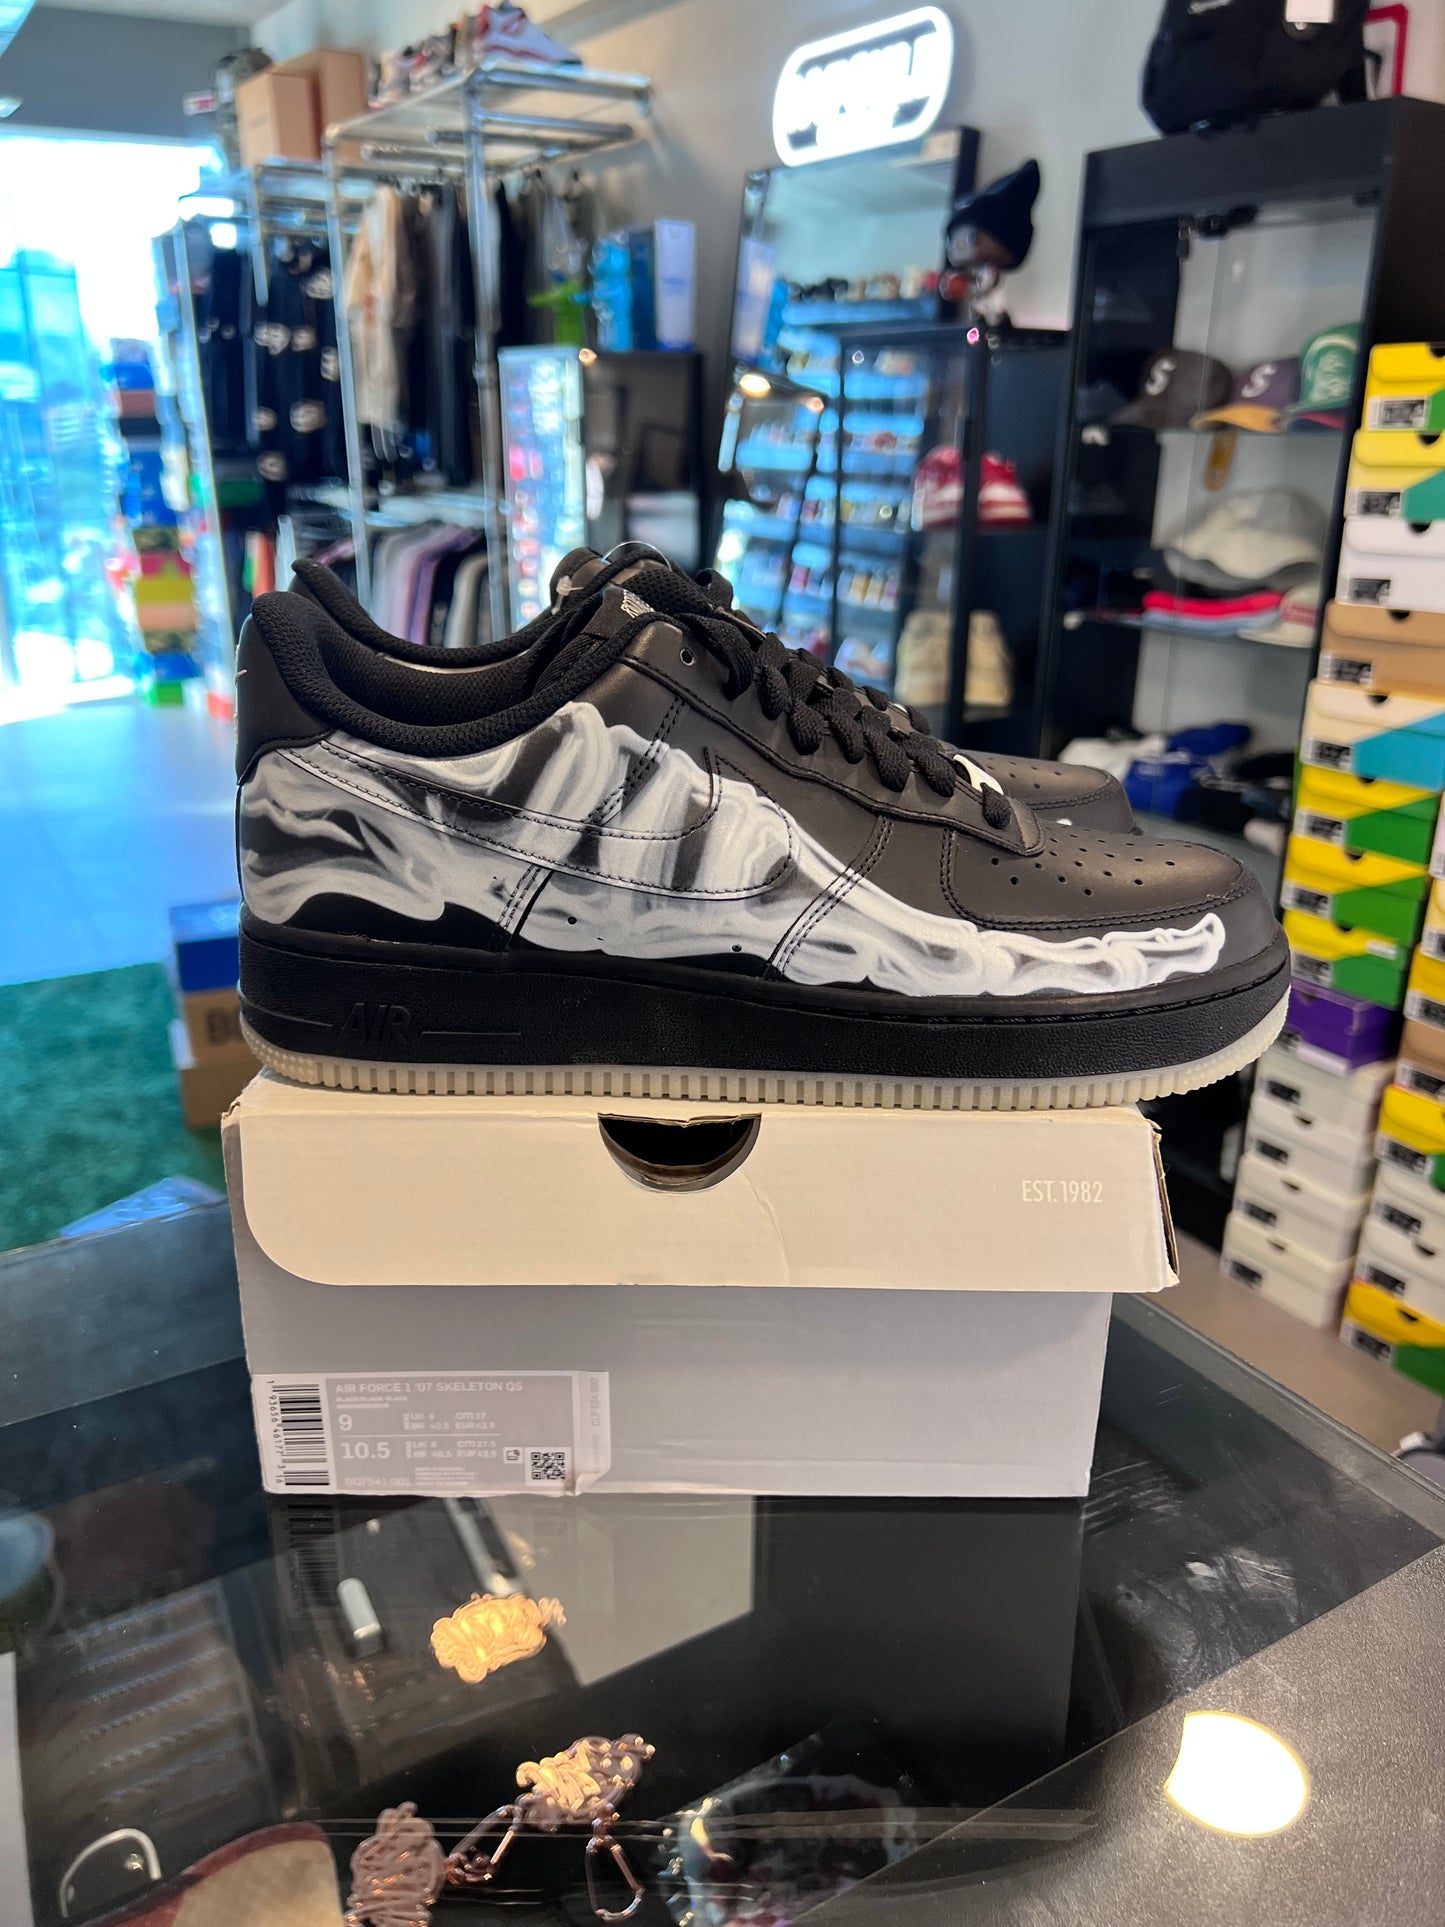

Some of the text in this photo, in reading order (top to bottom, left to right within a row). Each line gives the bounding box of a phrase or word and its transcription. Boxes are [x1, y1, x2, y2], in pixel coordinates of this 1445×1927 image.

[337, 1001, 412, 1047] AIR
[335, 1381, 525, 1393] AIR FORCE 1 '07 SKELETON QS
[338, 1413, 353, 1432] 9
[341, 1441, 391, 1460] 10.5
